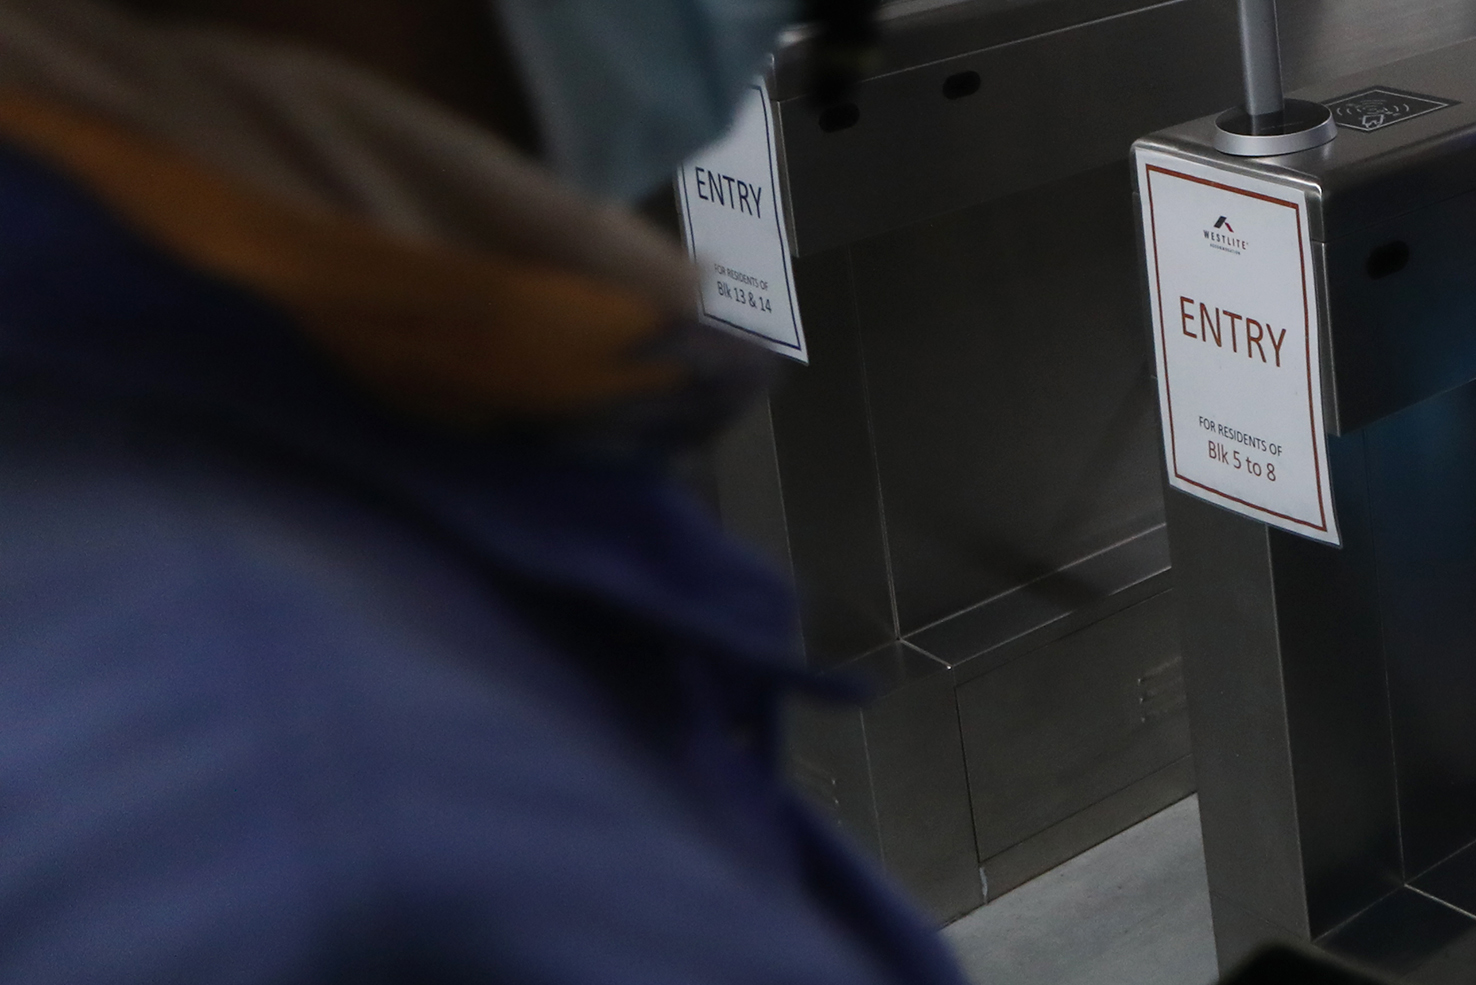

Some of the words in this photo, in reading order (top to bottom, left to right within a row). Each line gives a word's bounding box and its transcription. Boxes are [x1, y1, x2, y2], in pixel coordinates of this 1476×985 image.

[694, 166, 763, 220] ENTRY
[1203, 229, 1247, 251] WESTLITE
[714, 263, 726, 275] FOR
[726, 267, 759, 288] RESIDENTS
[760, 279, 769, 291] OF
[717, 280, 732, 300] Blk
[733, 287, 746, 305] 13
[747, 291, 758, 309] &
[759, 296, 772, 314] 14
[1179, 295, 1287, 368] ENTRY
[1199, 415, 1216, 433] FOR
[1218, 423, 1267, 452] RESIDENTS
[1269, 443, 1283, 456] OF
[1208, 440, 1229, 465] Blk
[1233, 450, 1242, 469] 5
[1245, 456, 1262, 477] to
[1266, 463, 1276, 482] 8
